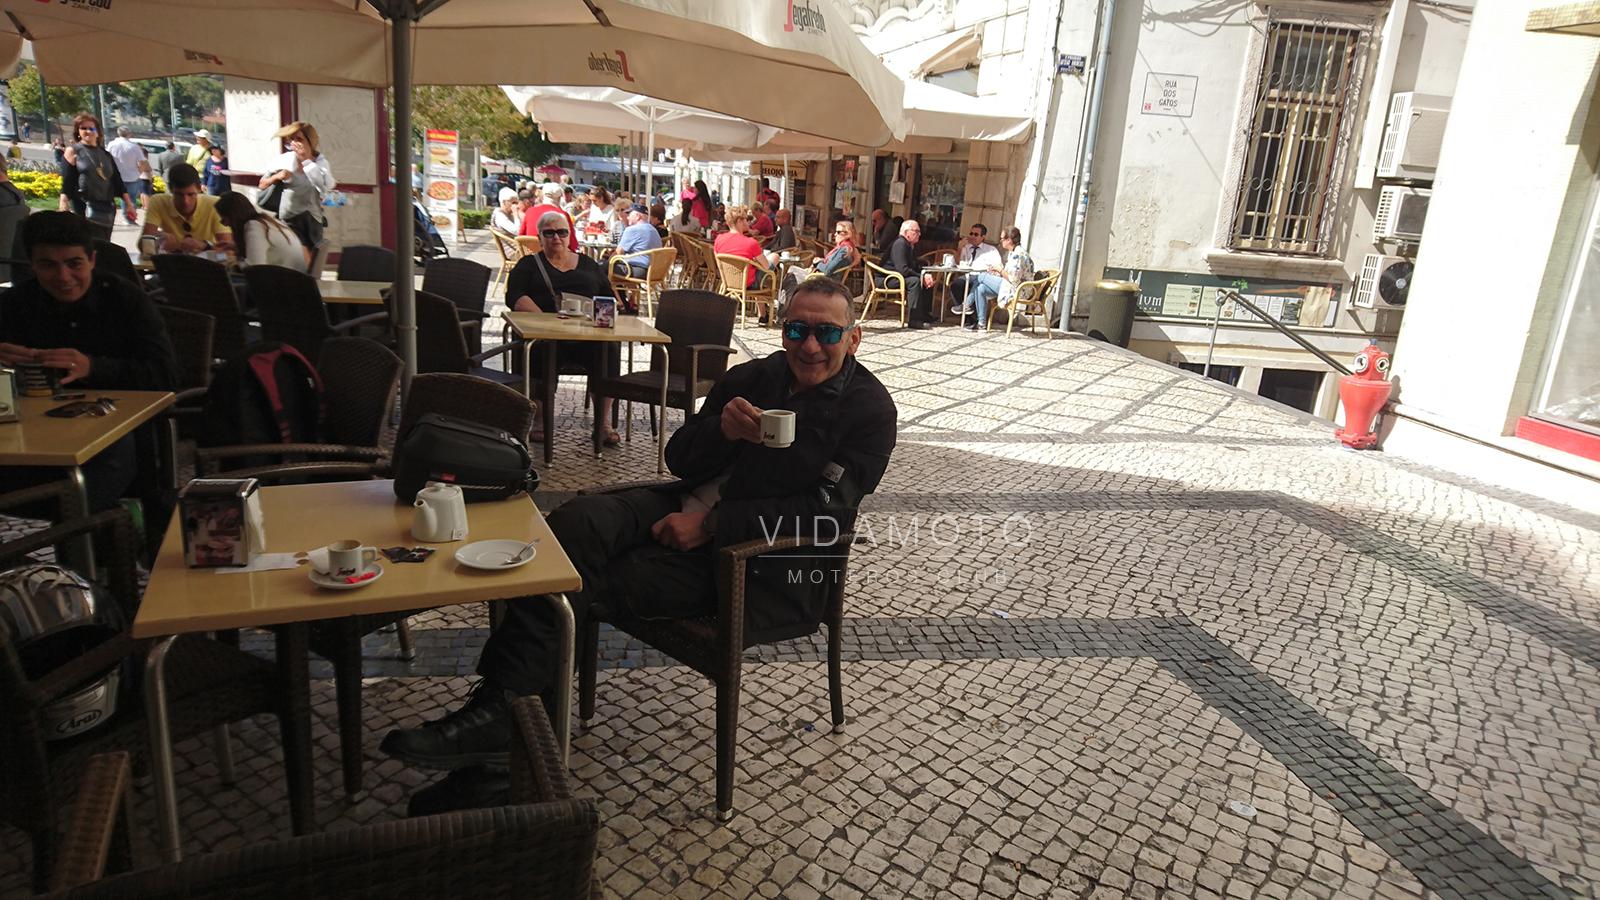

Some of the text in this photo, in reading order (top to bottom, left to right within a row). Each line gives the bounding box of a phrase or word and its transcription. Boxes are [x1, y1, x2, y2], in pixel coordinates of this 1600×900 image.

[1164, 80, 1177, 88] RUA
[1163, 89, 1177, 97] DOS
[1158, 98, 1178, 107] GATOS
